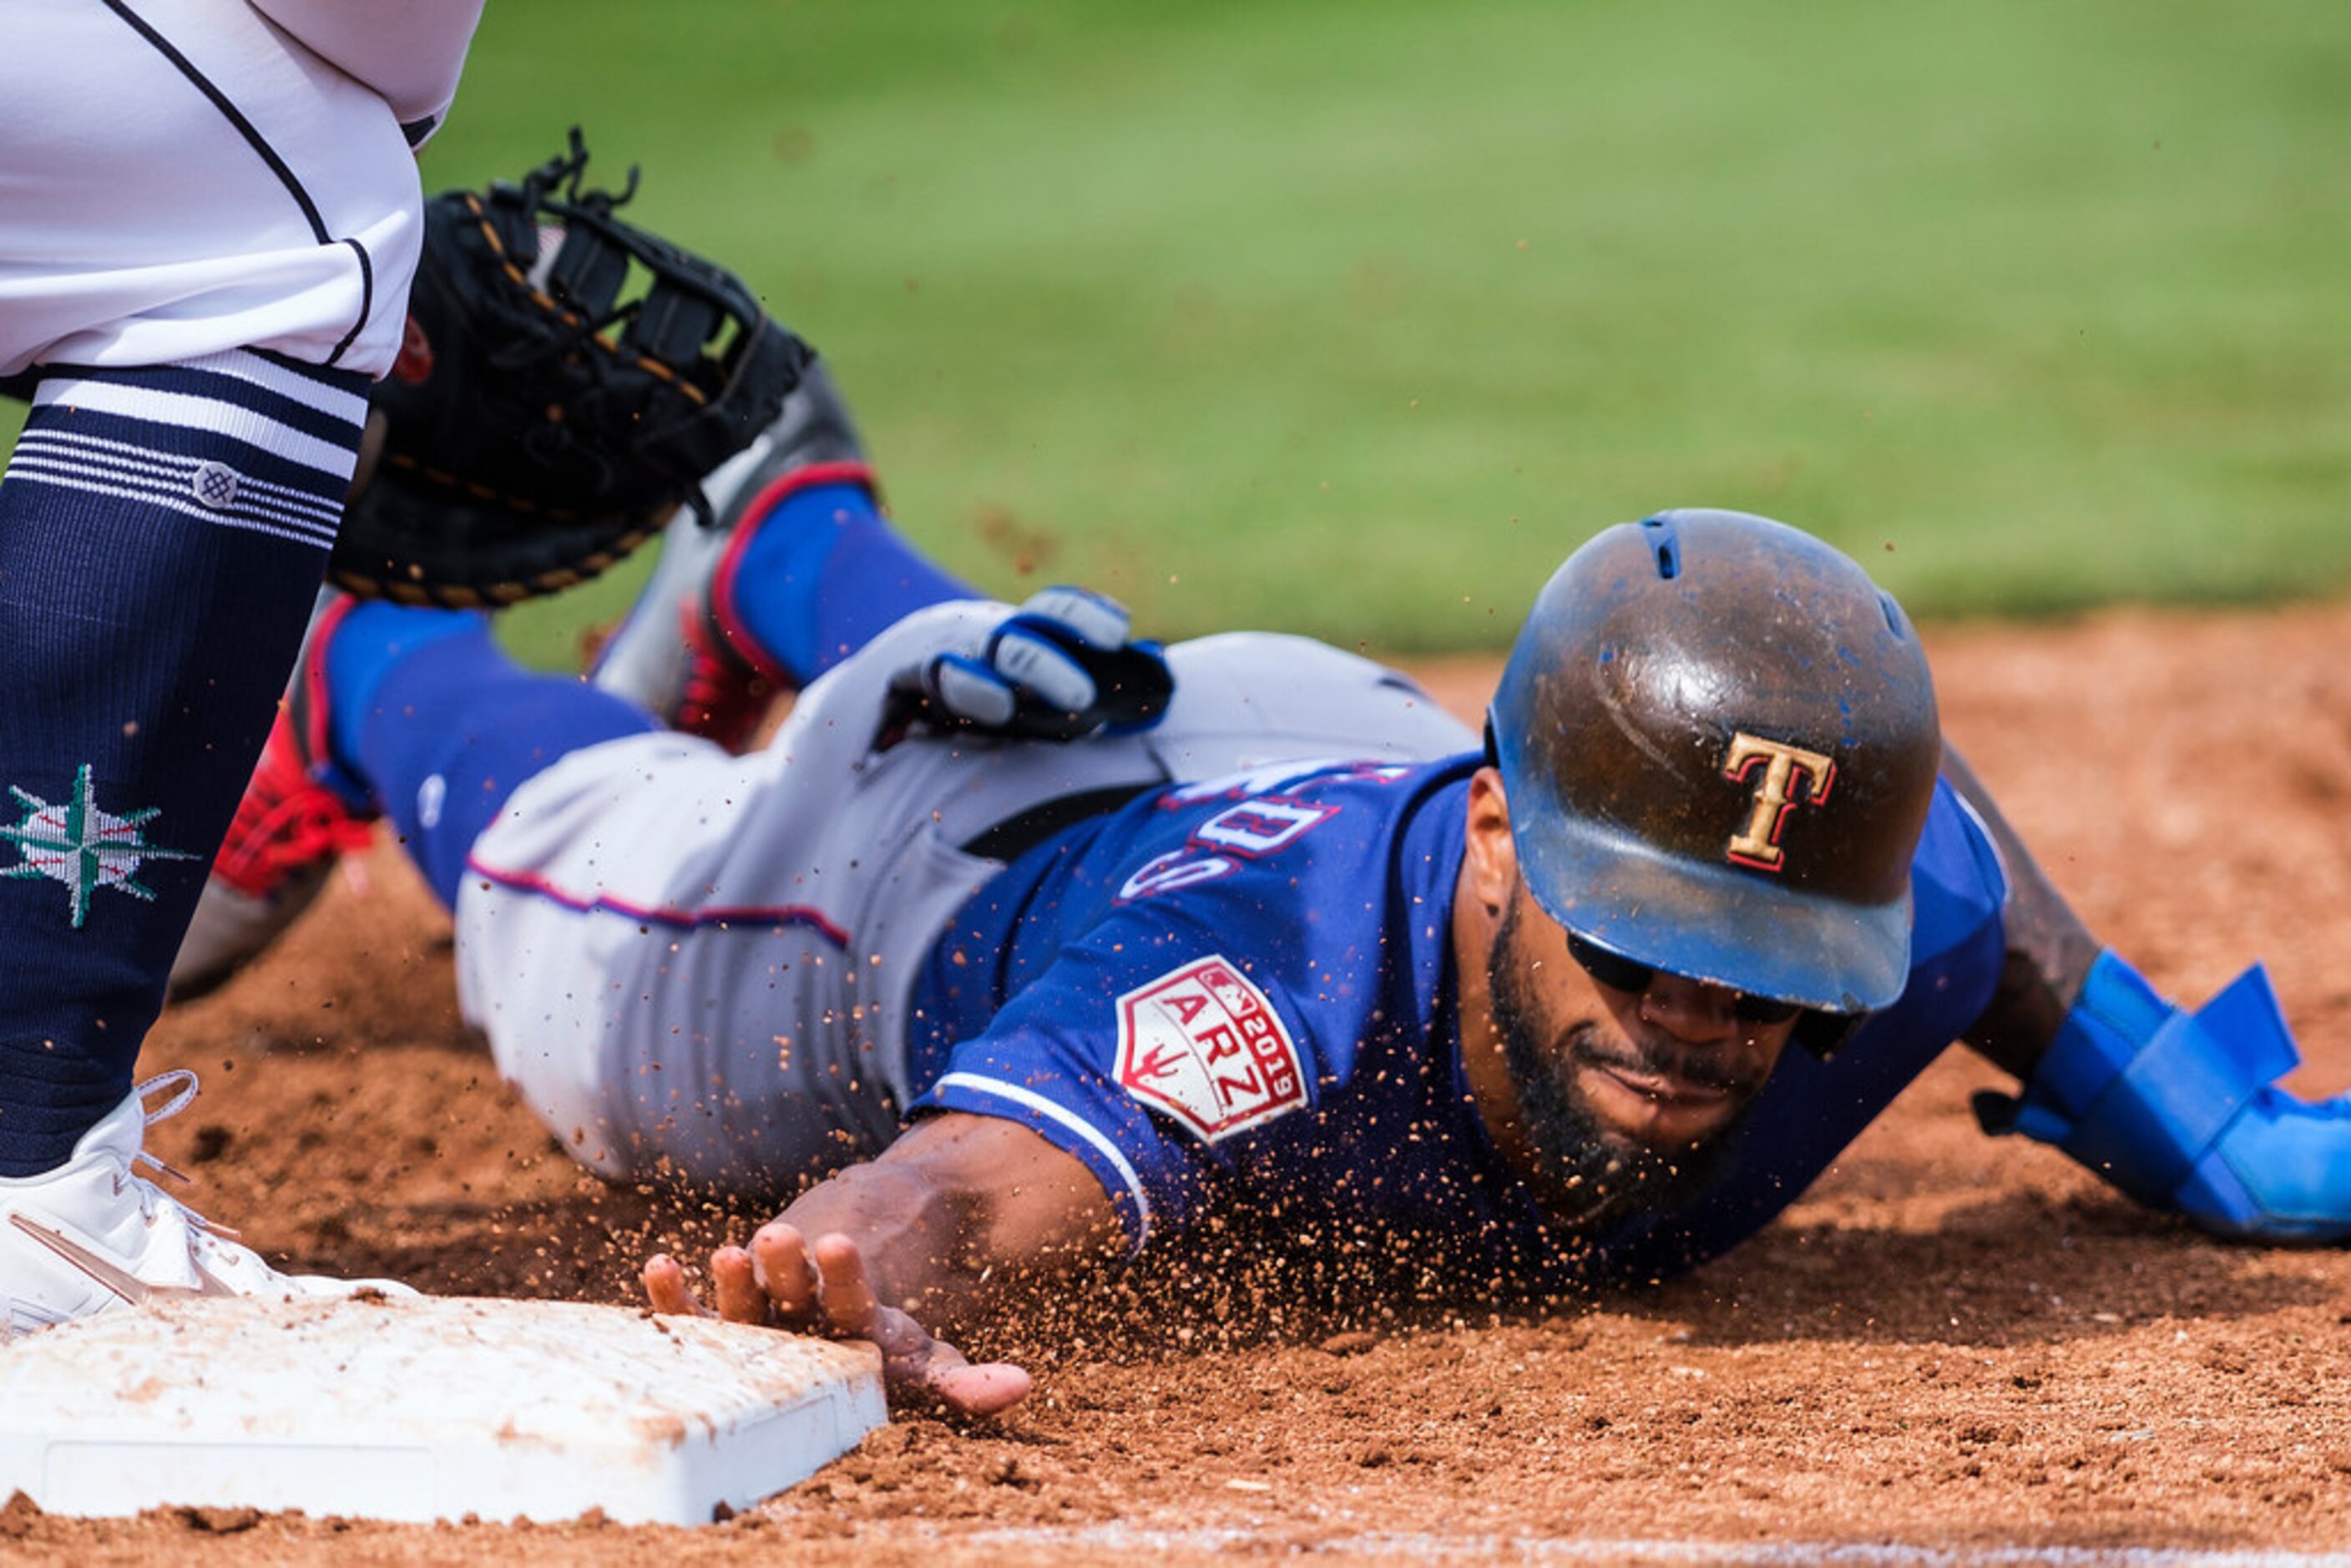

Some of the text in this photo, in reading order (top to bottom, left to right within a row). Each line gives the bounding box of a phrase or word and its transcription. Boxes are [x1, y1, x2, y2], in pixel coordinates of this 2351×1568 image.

[1723, 731, 1837, 873] T
[1161, 994, 1261, 1108] ARZ
[1242, 1015, 1295, 1099] 2019
